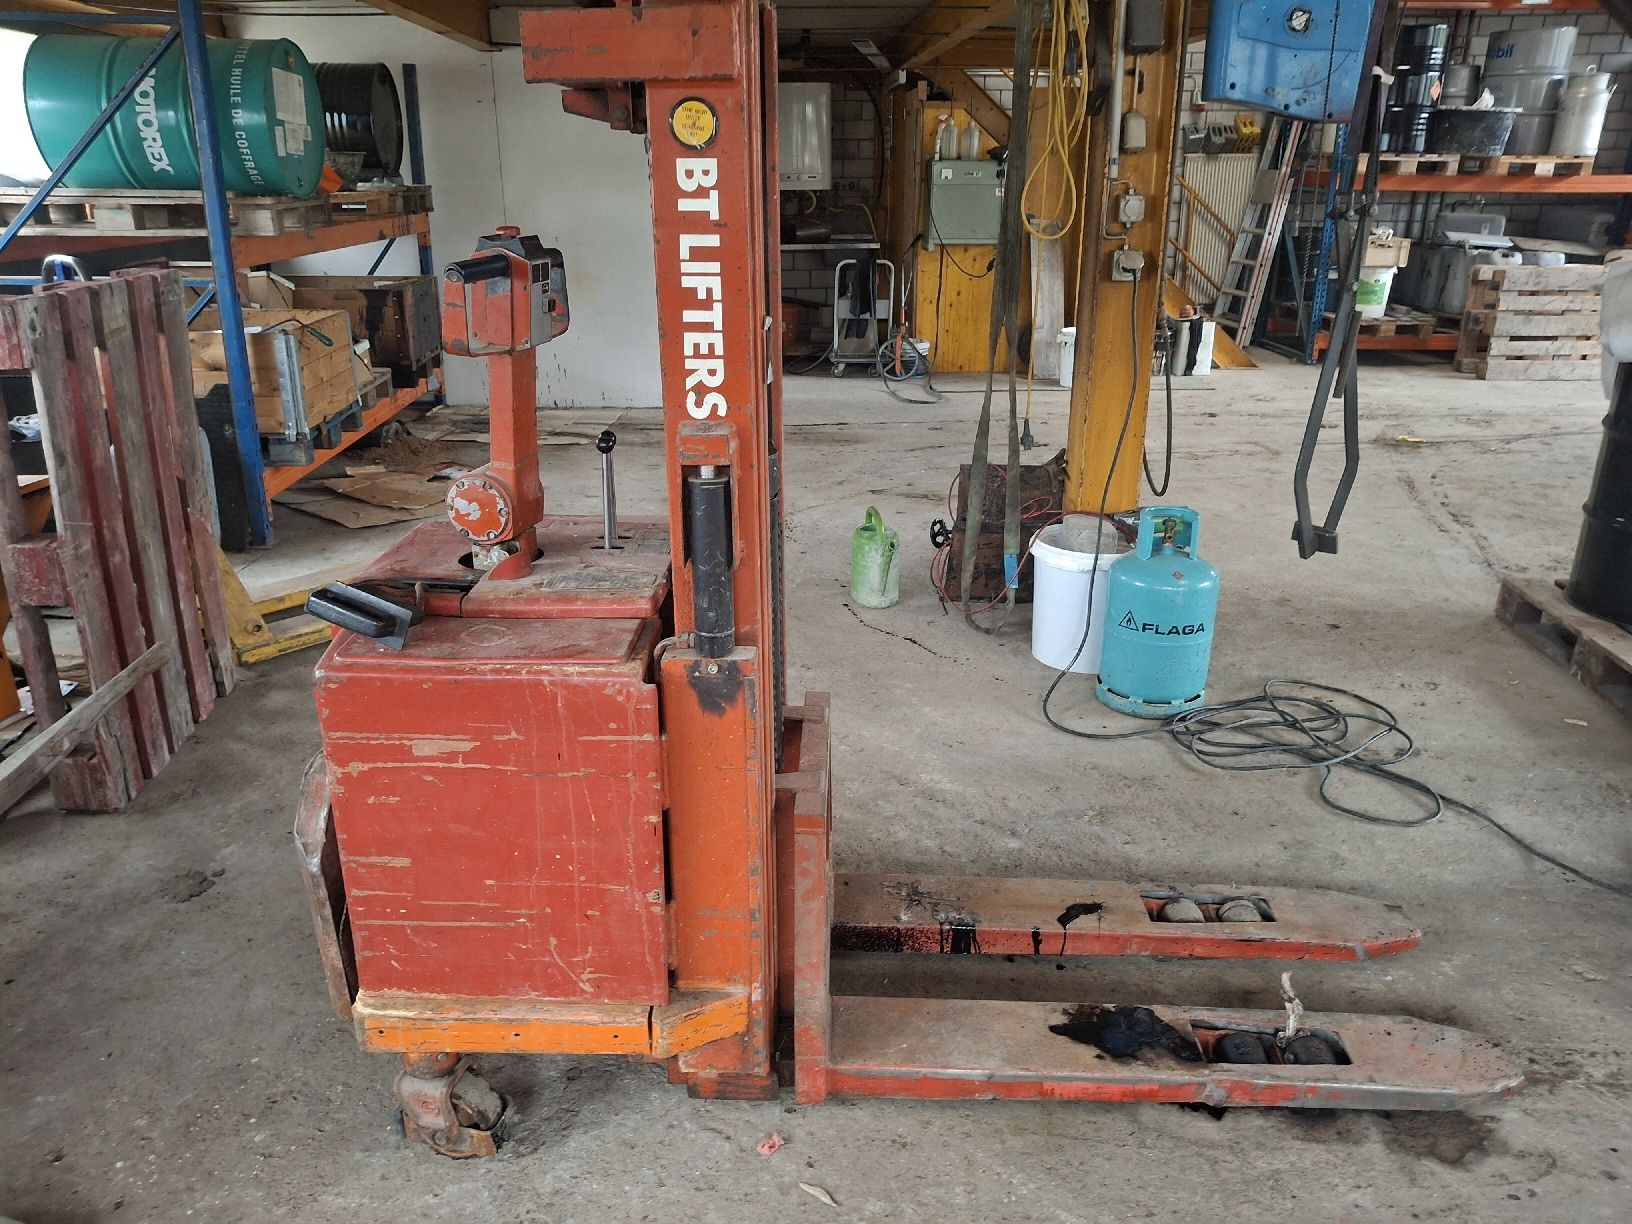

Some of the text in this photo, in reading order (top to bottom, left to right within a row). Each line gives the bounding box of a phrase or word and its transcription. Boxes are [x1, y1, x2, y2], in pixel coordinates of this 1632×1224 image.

[230, 68, 243, 104] HUILE
[231, 109, 243, 126] DE
[676, 158, 719, 220] BT
[680, 234, 727, 419] LIFTERS
[1141, 622, 1205, 636] FLAGA
